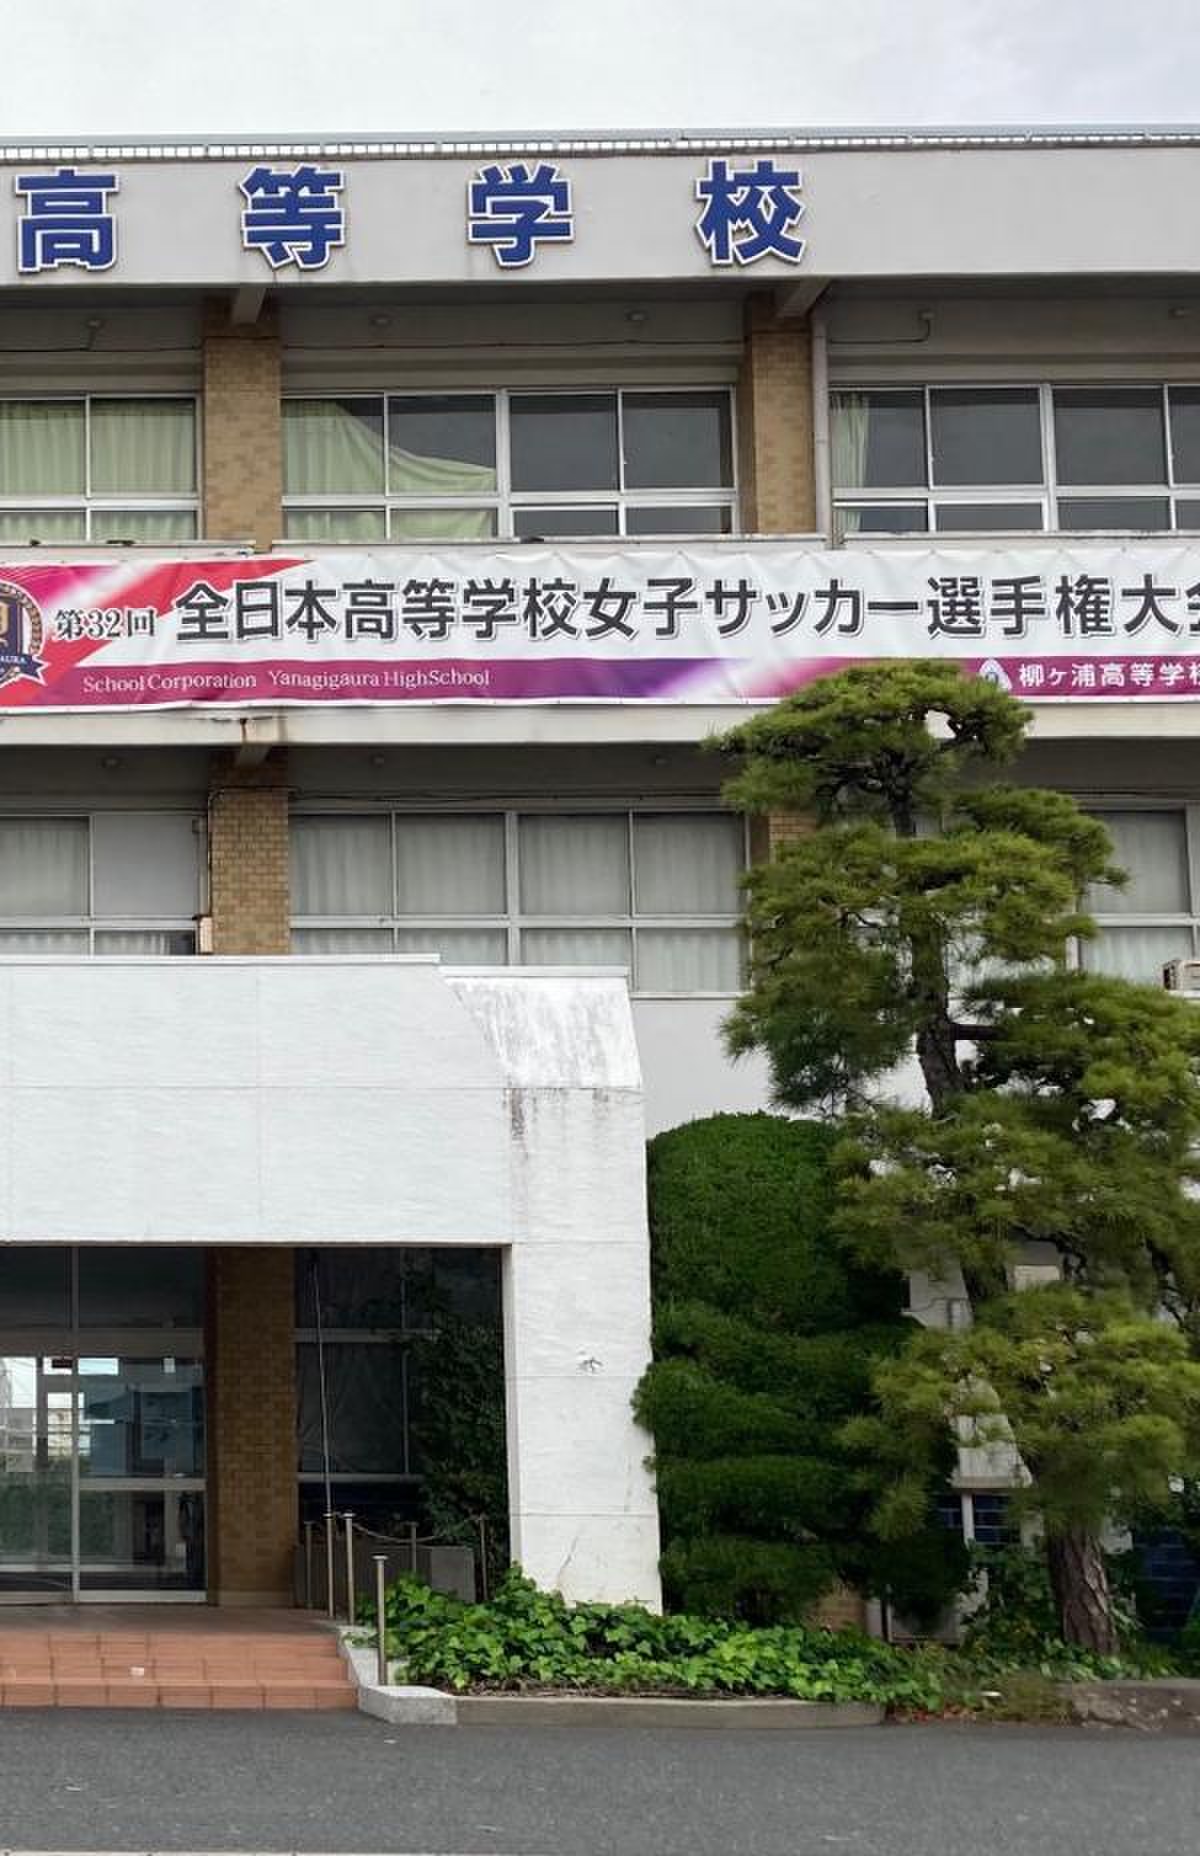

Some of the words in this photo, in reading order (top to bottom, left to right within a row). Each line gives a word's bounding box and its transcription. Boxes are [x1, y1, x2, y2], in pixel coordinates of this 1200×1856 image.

[56, 608, 156, 639] 第32回
[175, 573, 1200, 641] 全日本高等学校女子サッカー選手権大
[83, 675, 144, 692] School
[147, 671, 257, 692] Corporation
[269, 669, 380, 689] Yanagigaura
